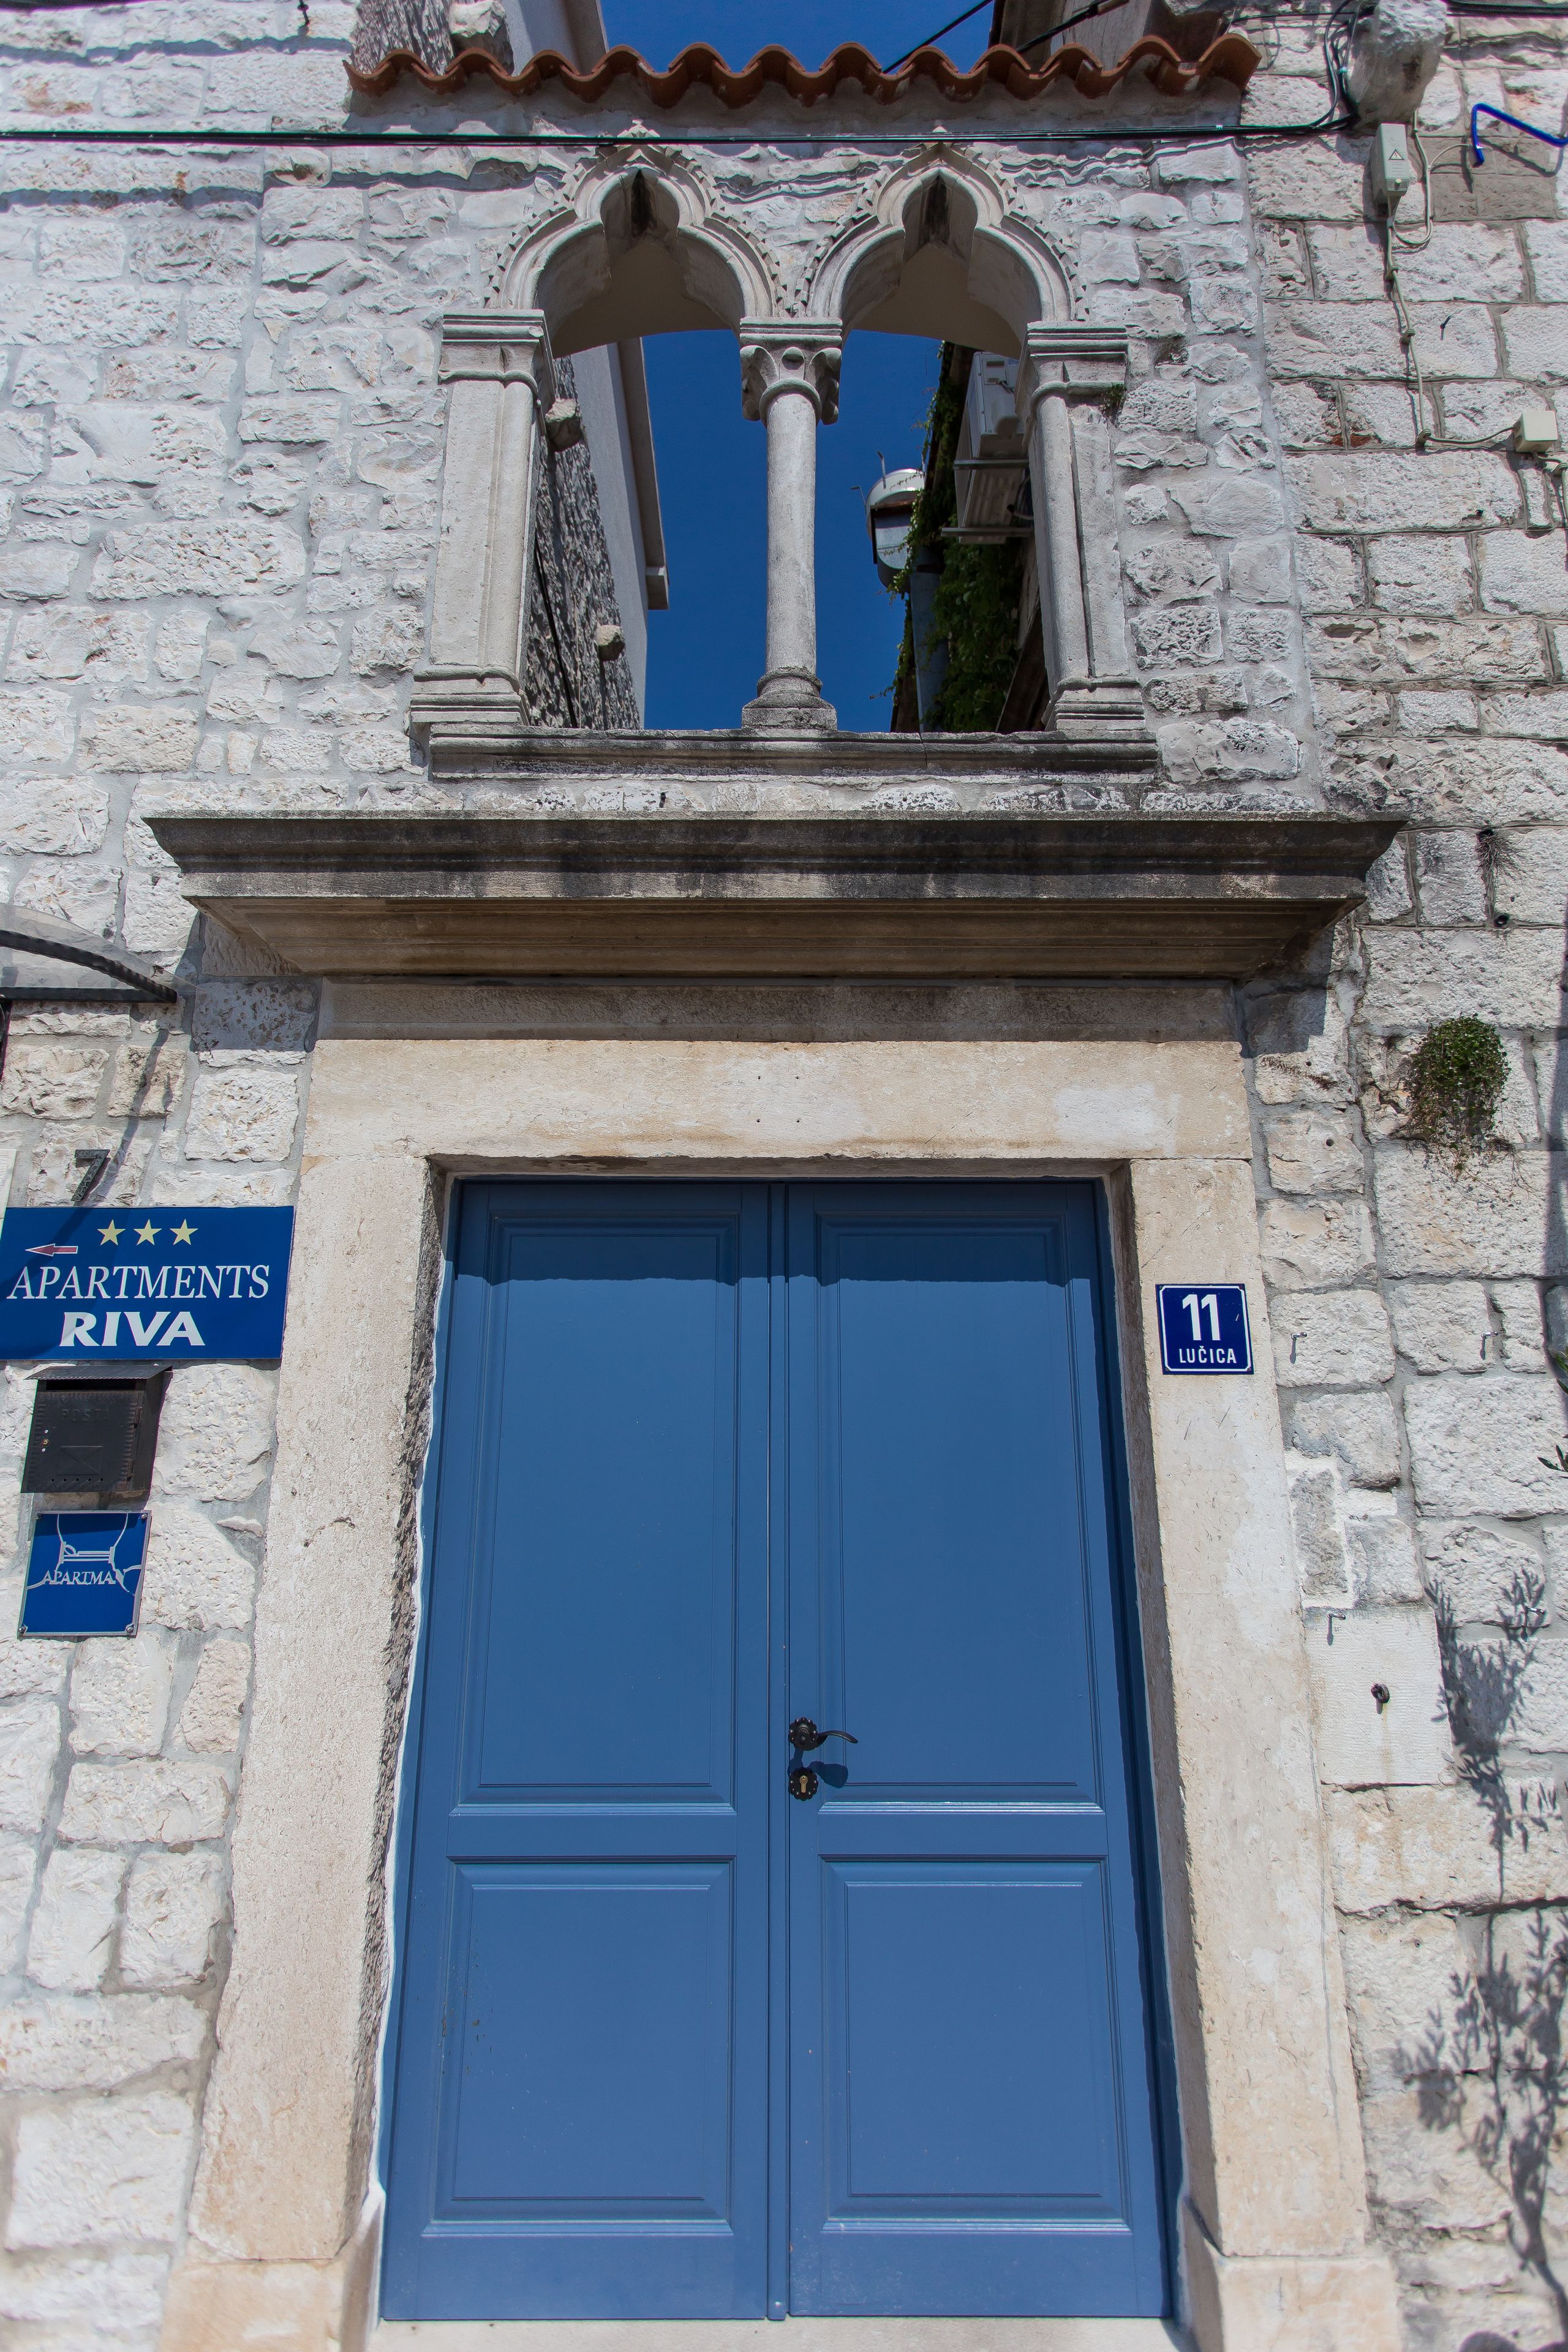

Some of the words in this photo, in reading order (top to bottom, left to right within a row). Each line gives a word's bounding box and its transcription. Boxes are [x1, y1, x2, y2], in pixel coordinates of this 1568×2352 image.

[71, 1149, 110, 1201] 7
[6, 1264, 270, 1299] APARTMENTS
[59, 1311, 206, 1347] RIVA
[1182, 1294, 1221, 1341] 11
[1179, 1346, 1237, 1363] LUČICA
